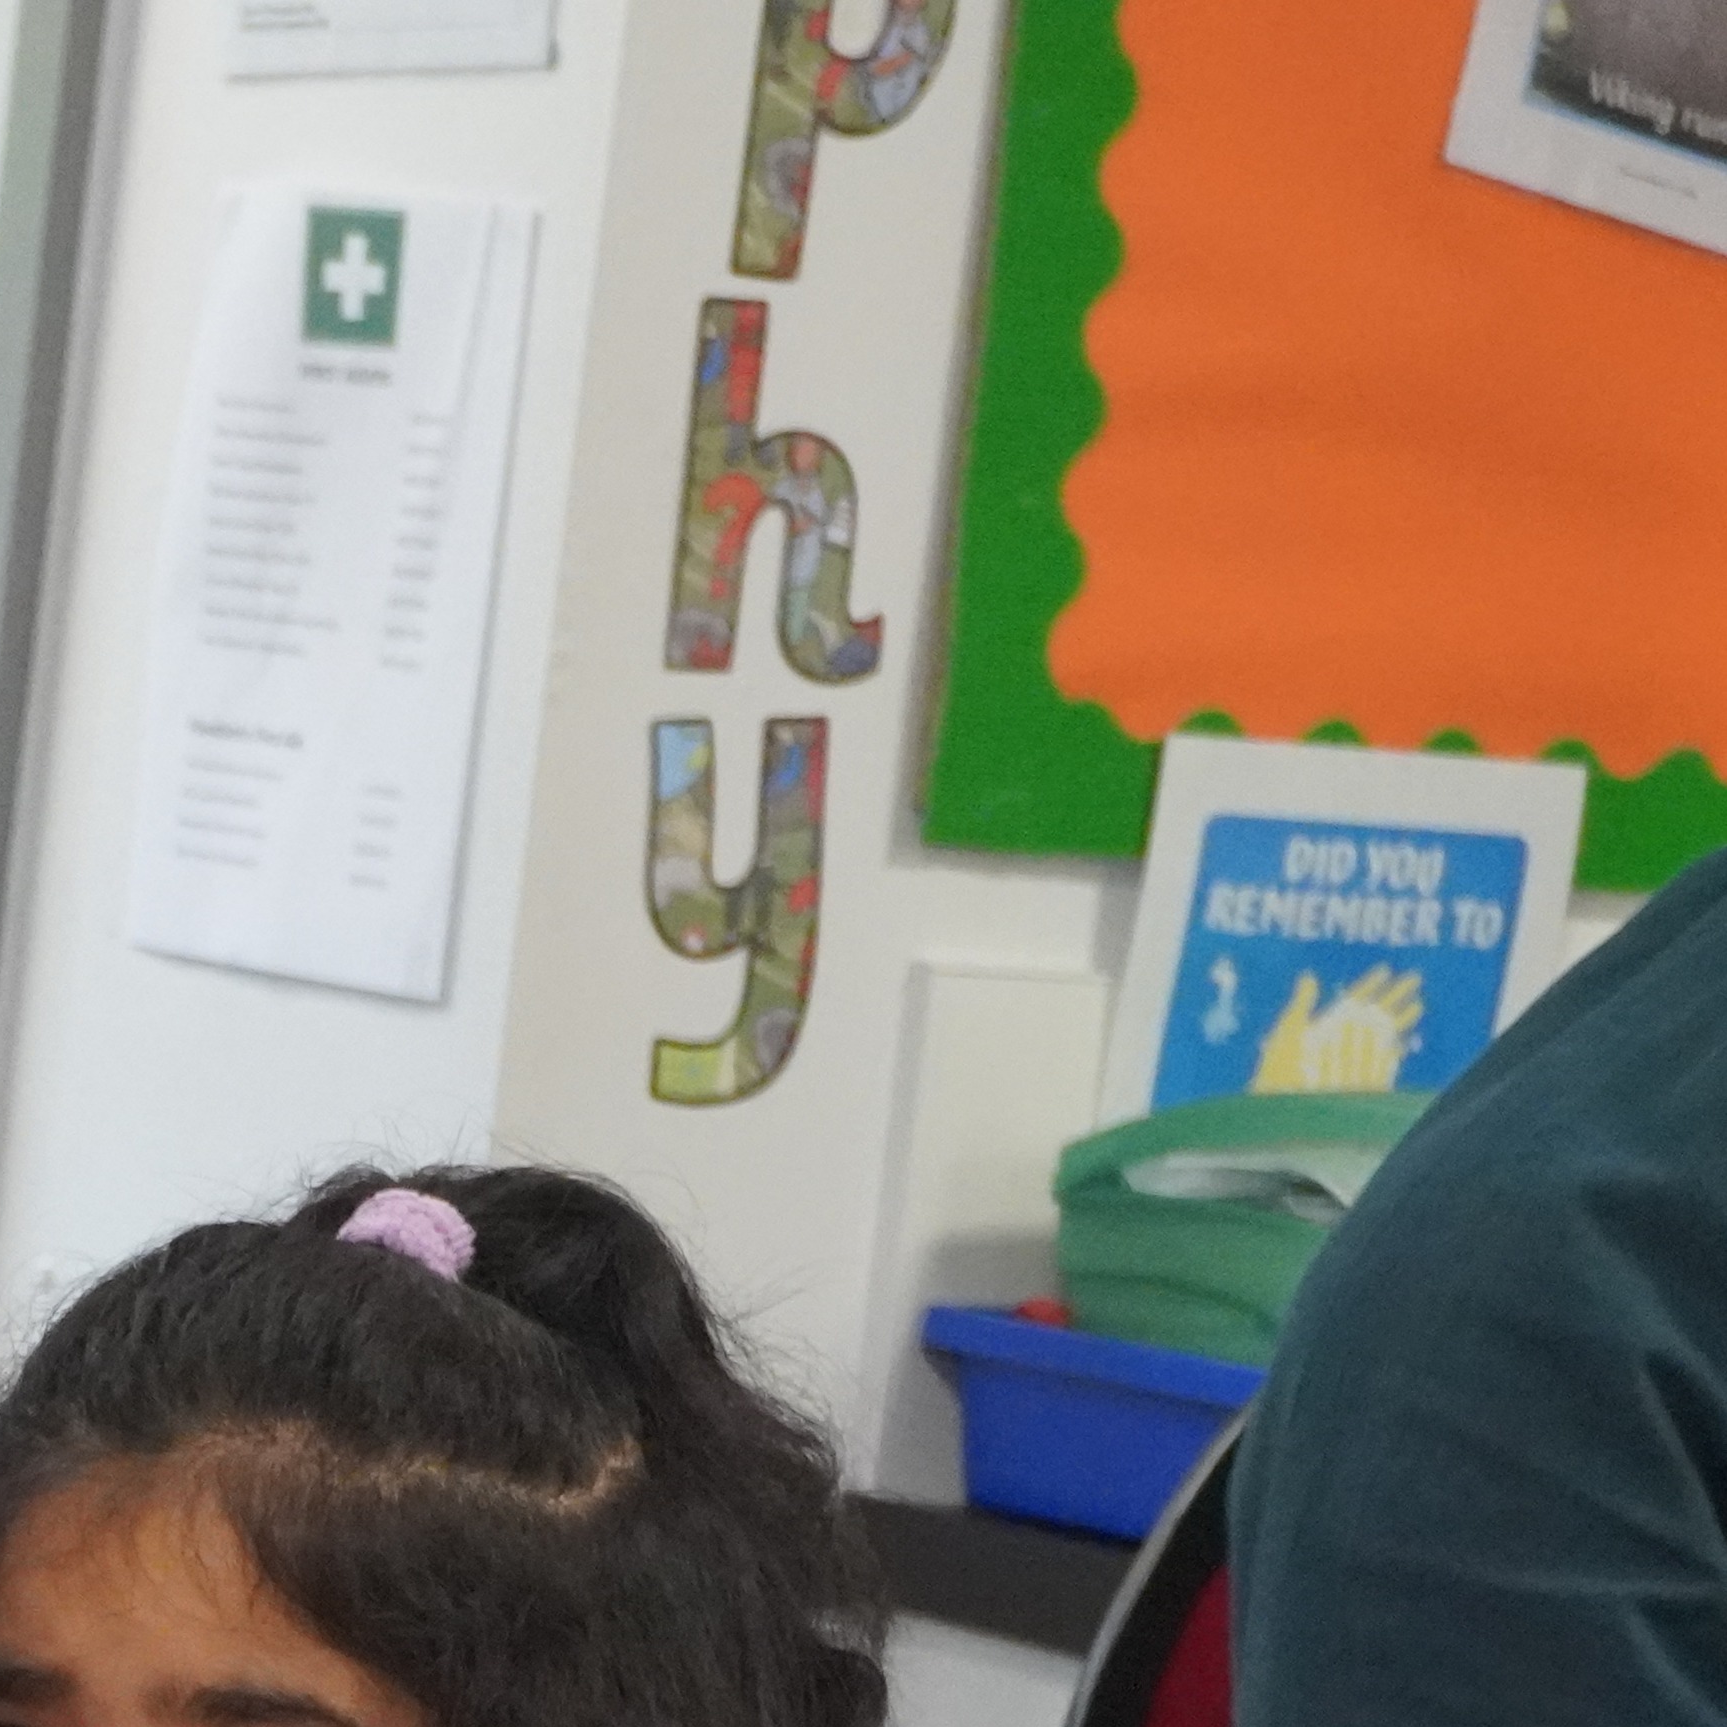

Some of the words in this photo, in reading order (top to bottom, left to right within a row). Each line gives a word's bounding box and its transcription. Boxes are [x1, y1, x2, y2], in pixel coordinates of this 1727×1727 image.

[1283, 835, 1358, 884] DID
[1367, 842, 1445, 896] YOU
[1203, 884, 1443, 947] REMEMBER
[1452, 898, 1504, 950] TO
